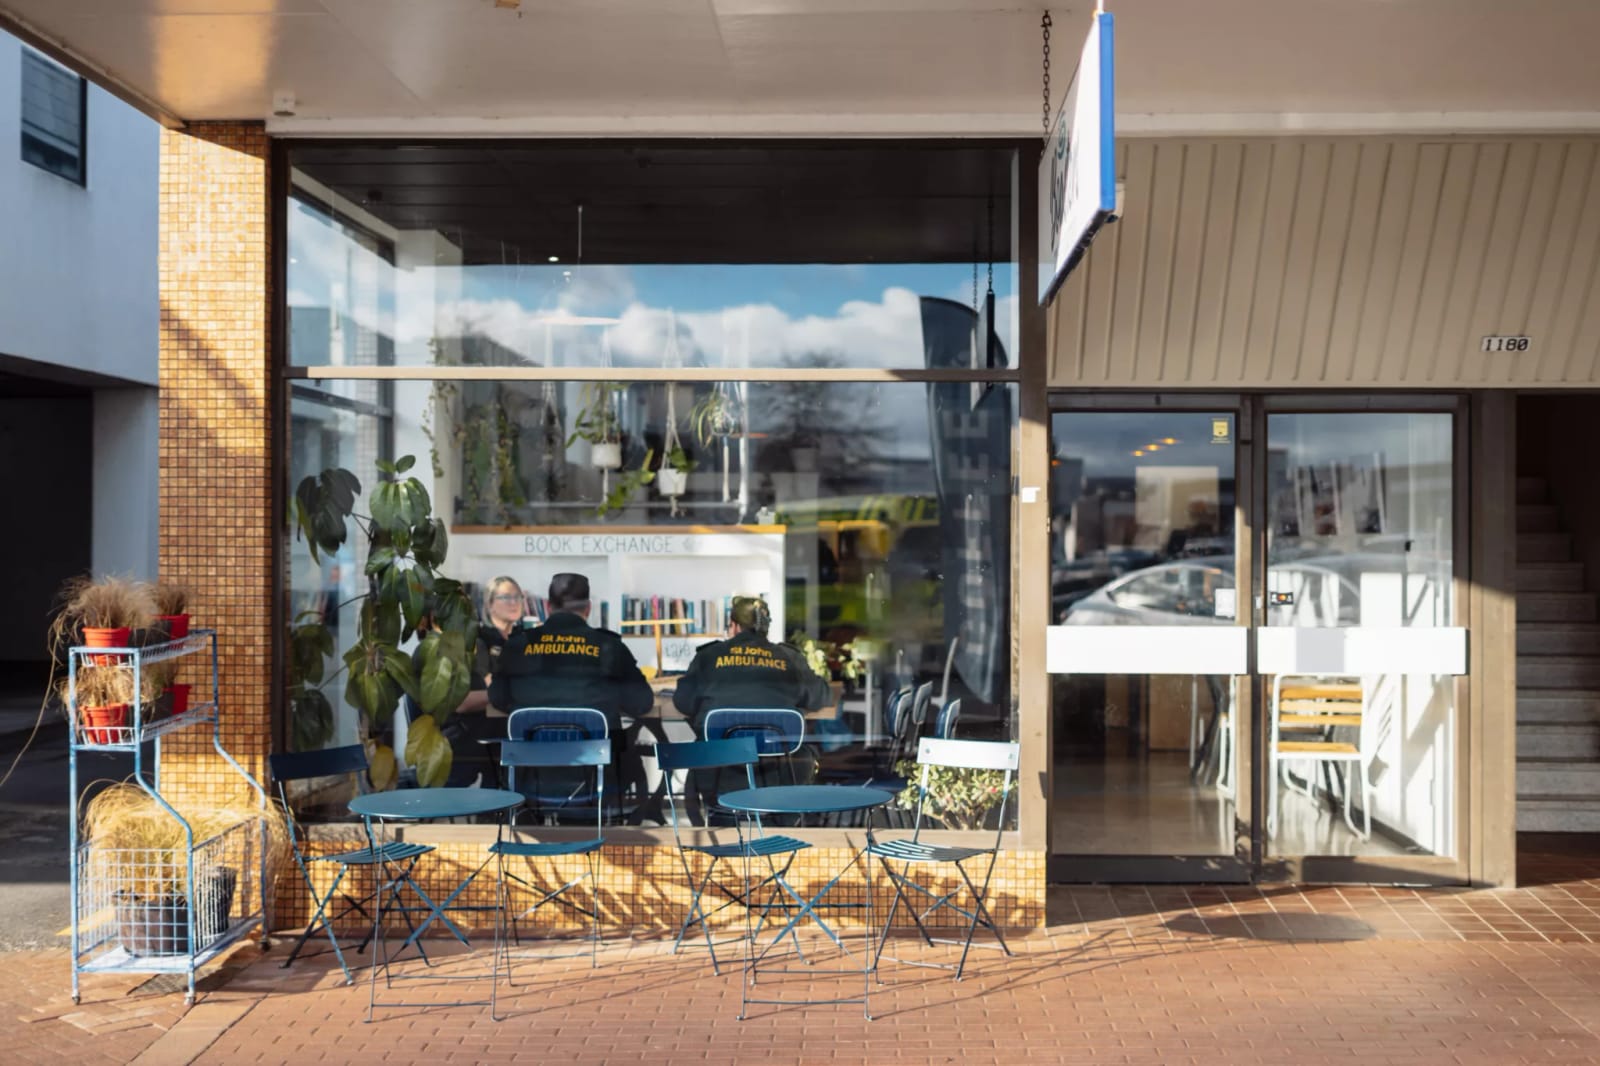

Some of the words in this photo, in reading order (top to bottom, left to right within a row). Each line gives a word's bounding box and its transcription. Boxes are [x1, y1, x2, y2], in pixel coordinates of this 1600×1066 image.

[1486, 338, 1529, 351] 1180
[524, 536, 571, 553] BOOK
[581, 536, 673, 553] EXCHANGE
[556, 635, 587, 644] John
[524, 643, 600, 658] AMBULANCE
[745, 646, 773, 658] John
[715, 655, 788, 672] AMBULANCE
